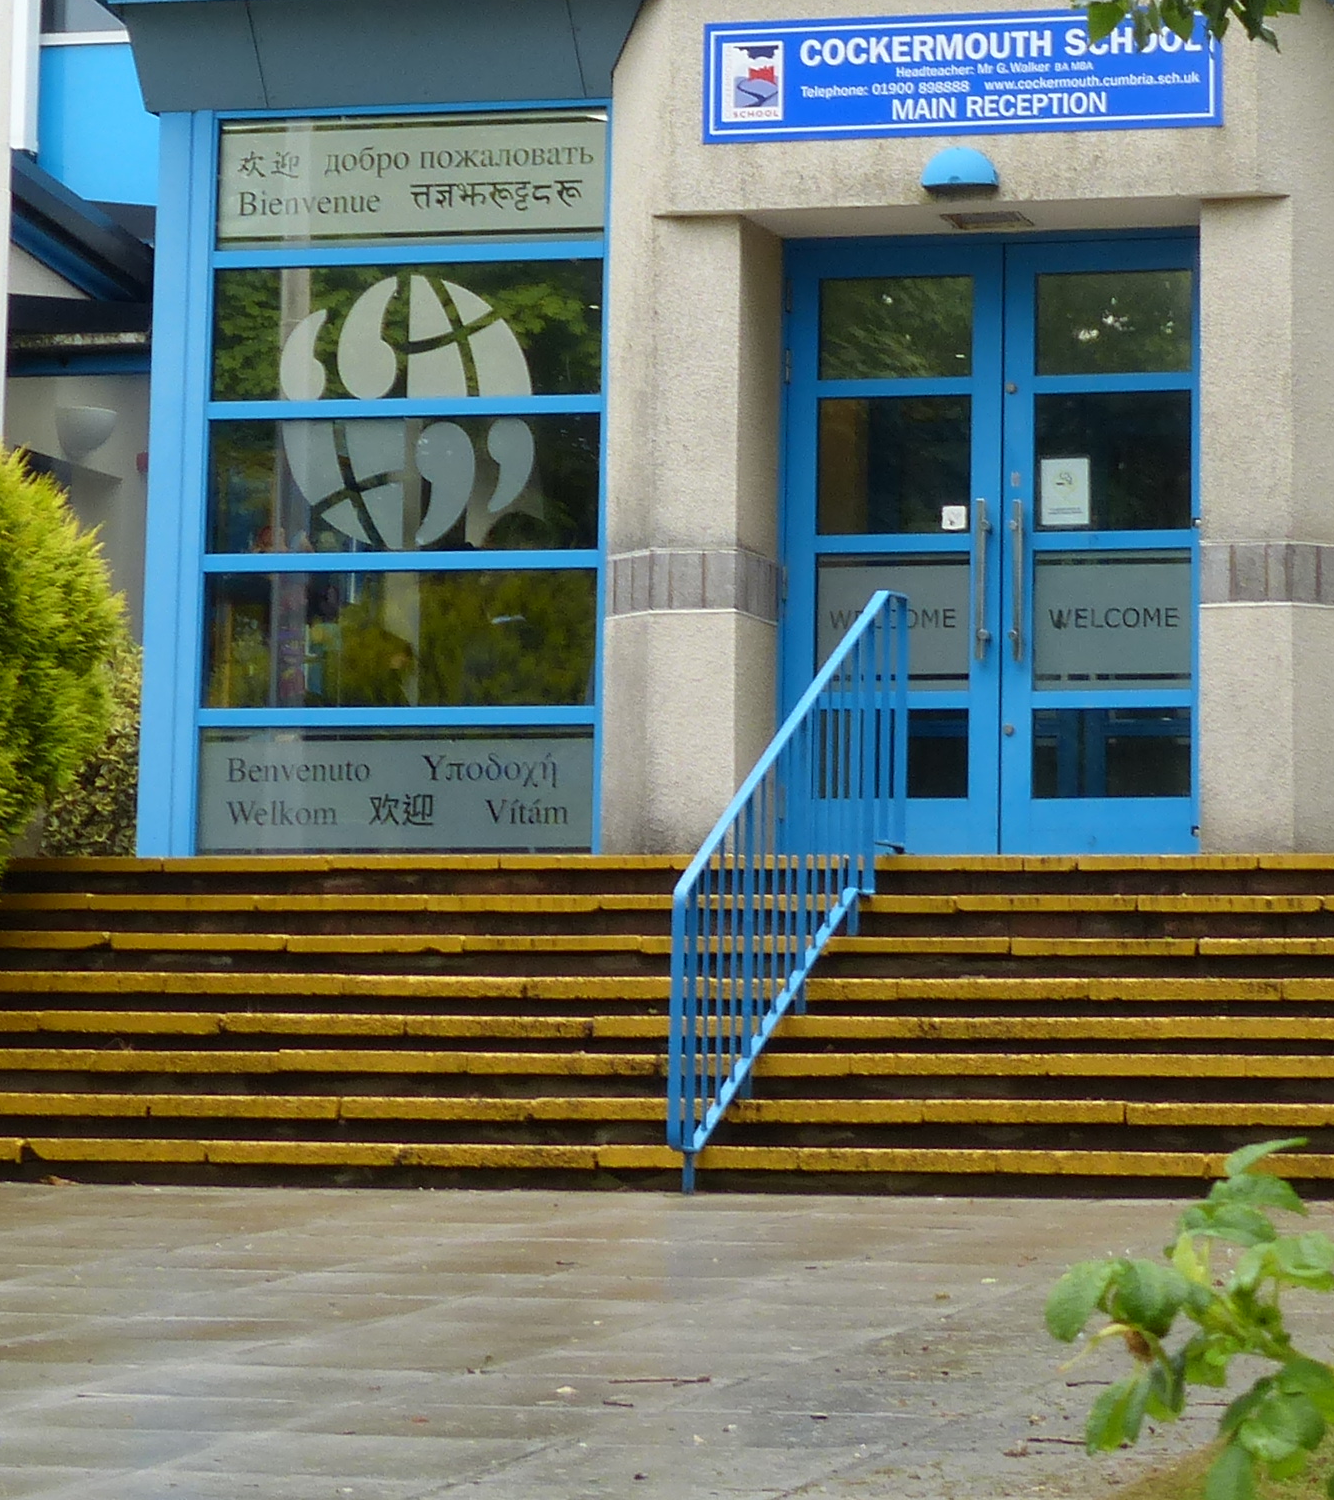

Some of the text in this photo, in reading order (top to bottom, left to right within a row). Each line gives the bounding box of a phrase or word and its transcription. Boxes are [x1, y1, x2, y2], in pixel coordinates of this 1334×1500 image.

[800, 29, 1053, 67] COCKERMOUTH
[896, 63, 975, 78] Headteacher:
[977, 62, 994, 75] Mr
[1010, 61, 1051, 73] Walker
[801, 85, 868, 100] Telephone:
[872, 81, 915, 95] 01900
[984, 71, 1201, 91] www.cockermouth.cumbria.sch.uk
[733, 109, 780, 118] SCHOOL
[892, 91, 1108, 120] MAIN RECEPTION
[324, 146, 595, 178] добро пожаловать
[238, 190, 381, 217] Bienvenue
[829, 607, 957, 629] WOME
[1048, 607, 1180, 630] WELCOME
[226, 757, 371, 783] Benvenuto
[226, 800, 338, 827] Welkom
[368, 793, 435, 826] 欢迎
[484, 798, 569, 825] Vítám
